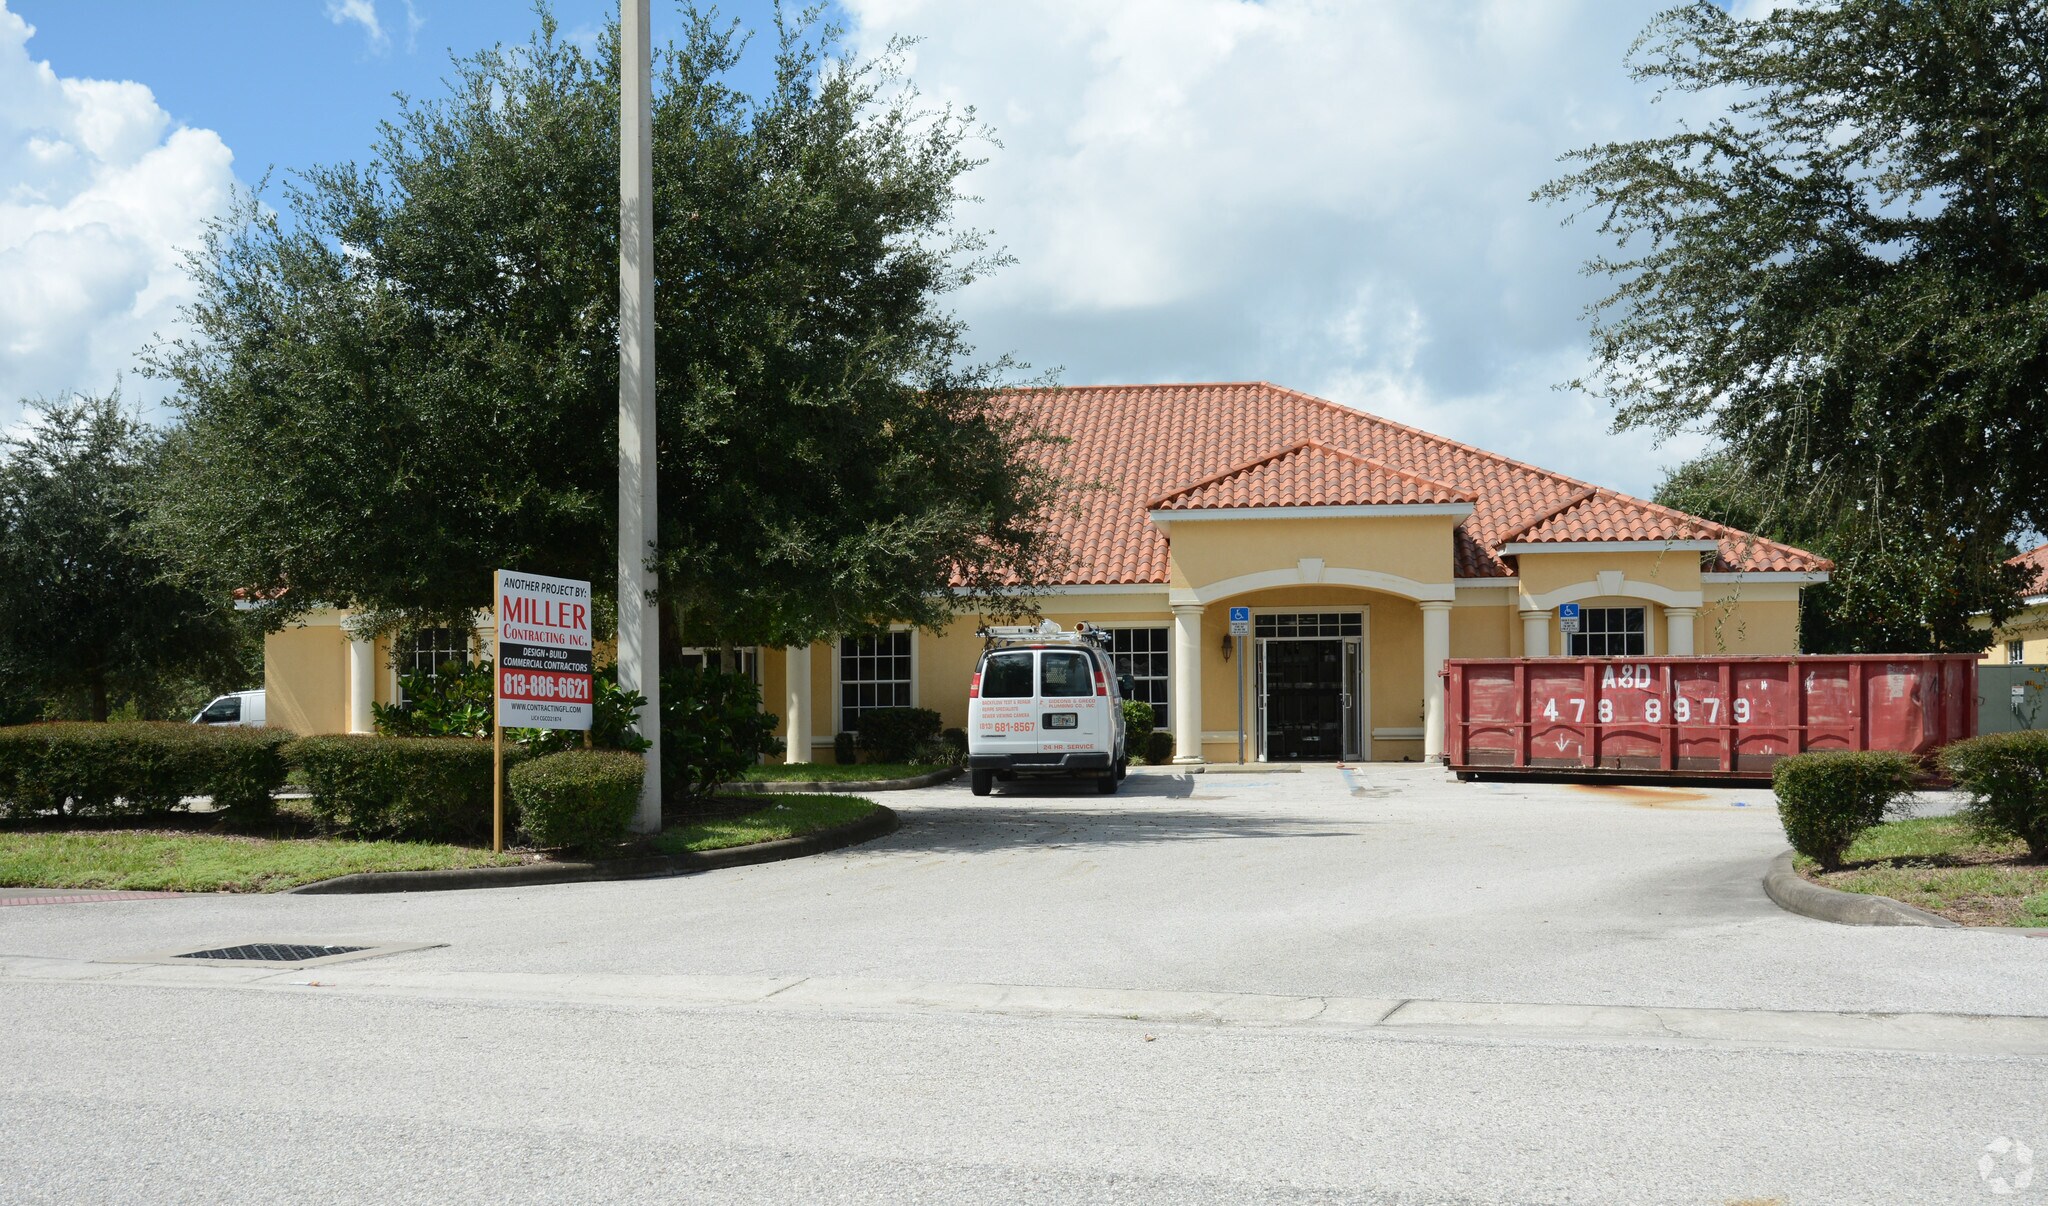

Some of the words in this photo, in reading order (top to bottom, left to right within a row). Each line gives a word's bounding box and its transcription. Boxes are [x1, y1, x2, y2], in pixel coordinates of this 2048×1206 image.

[504, 578, 540, 592] ANOTHER
[541, 583, 574, 596] PROJECT
[575, 587, 587, 598] BY:
[503, 595, 587, 630] MILLER
[503, 623, 565, 645] CONTRACTING
[569, 634, 588, 647] INC.
[523, 647, 545, 657] DESIGN
[549, 650, 568, 659] BUILD
[503, 657, 543, 669] COMMERCIAL
[544, 661, 588, 672] CONTRACTORS
[503, 672, 589, 699] 813-886-6621
[1601, 664, 1651, 689] A&D
[511, 702, 582, 714] WWW.CONTRACTINGFL.COM
[994, 722, 1036, 732] 681-8567
